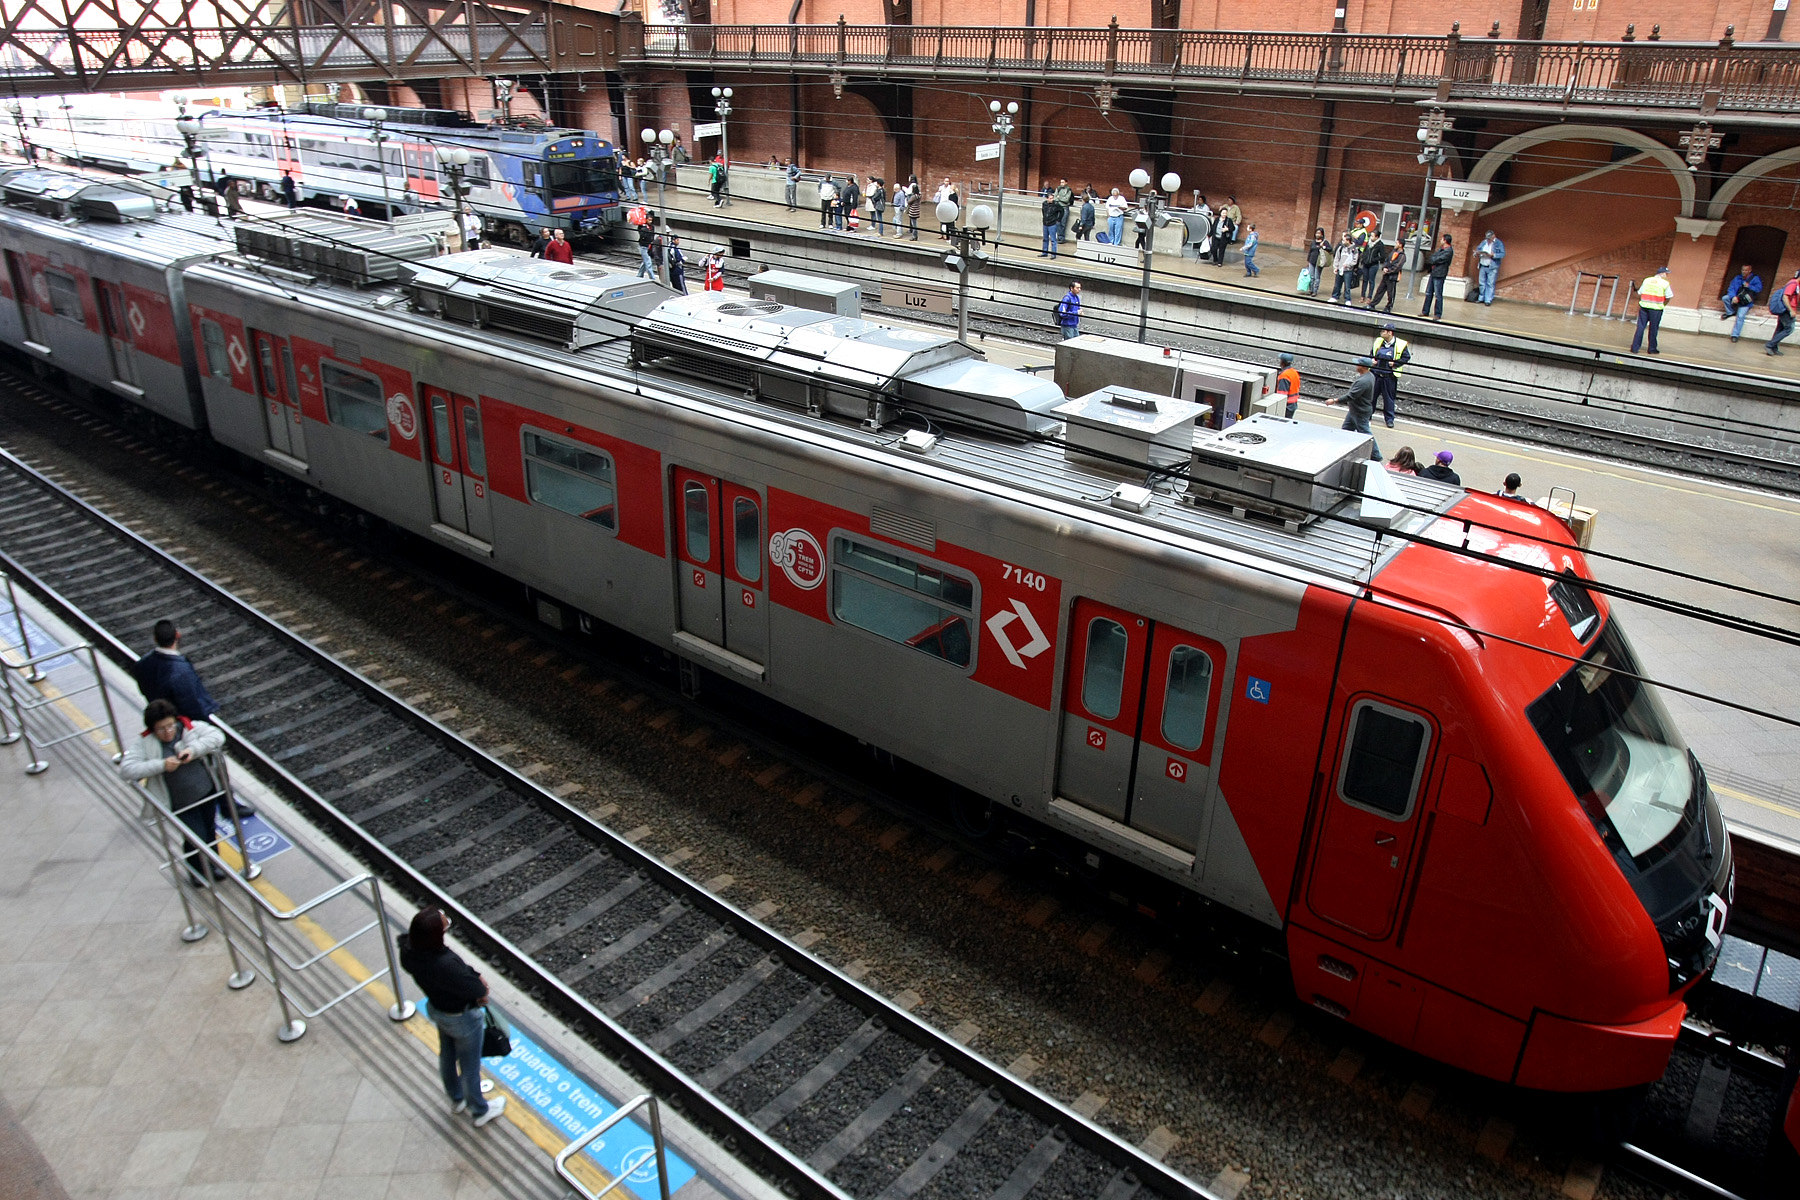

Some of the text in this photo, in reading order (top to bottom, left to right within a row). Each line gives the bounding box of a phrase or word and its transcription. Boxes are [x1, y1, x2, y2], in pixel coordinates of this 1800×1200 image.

[1453, 189, 1470, 198] Luz
[1097, 253, 1116, 265] Luz
[905, 293, 927, 308] Luz
[798, 553, 814, 564] TREM
[797, 565, 814, 576] CPTM
[1002, 563, 1046, 592] 7140
[510, 1037, 603, 1119] Aguarde o trem
[499, 1062, 606, 1153] da faixa amara
